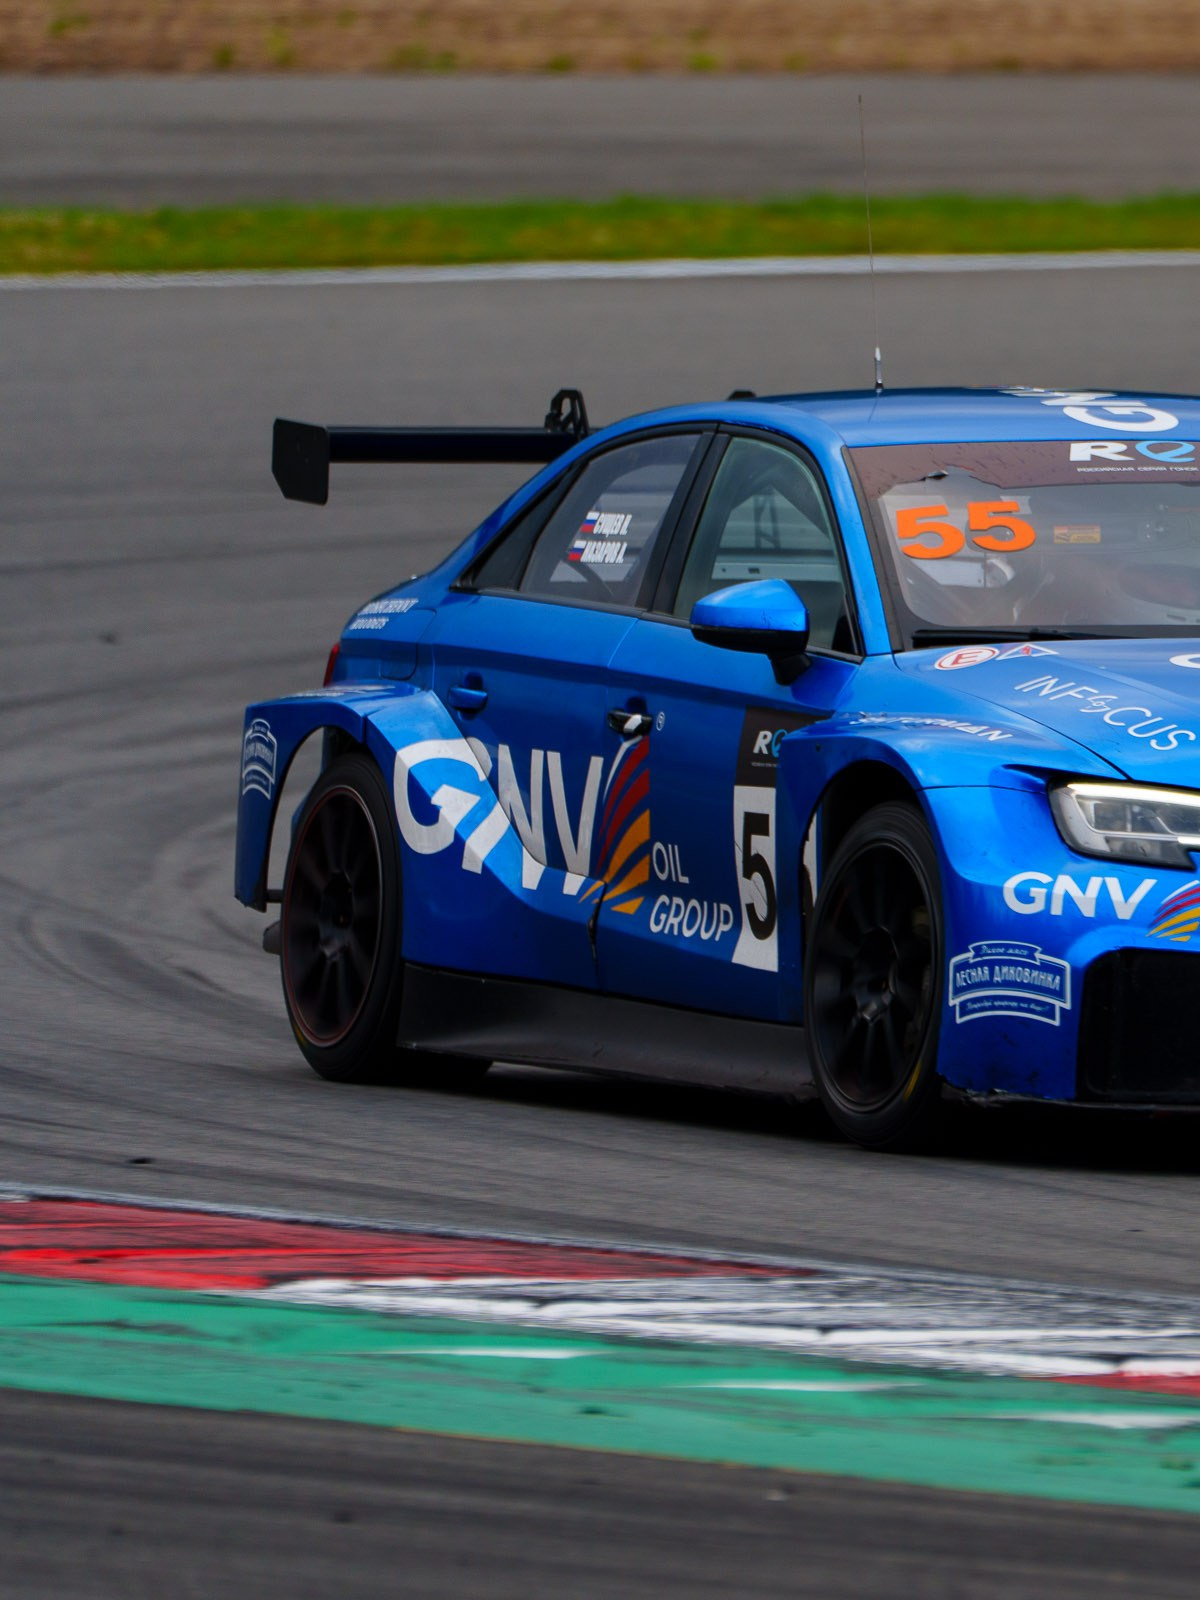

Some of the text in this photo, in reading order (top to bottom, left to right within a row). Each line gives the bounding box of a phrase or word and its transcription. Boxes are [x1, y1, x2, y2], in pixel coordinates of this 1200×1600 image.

[895, 499, 1037, 560] 55
[392, 737, 605, 896] GNV
[652, 841, 690, 884] OIL
[650, 894, 734, 942] GROUP
[1002, 871, 1158, 920] GNV
[955, 965, 1060, 991] ЛЕСНАЯ ДИКОВИНКА
